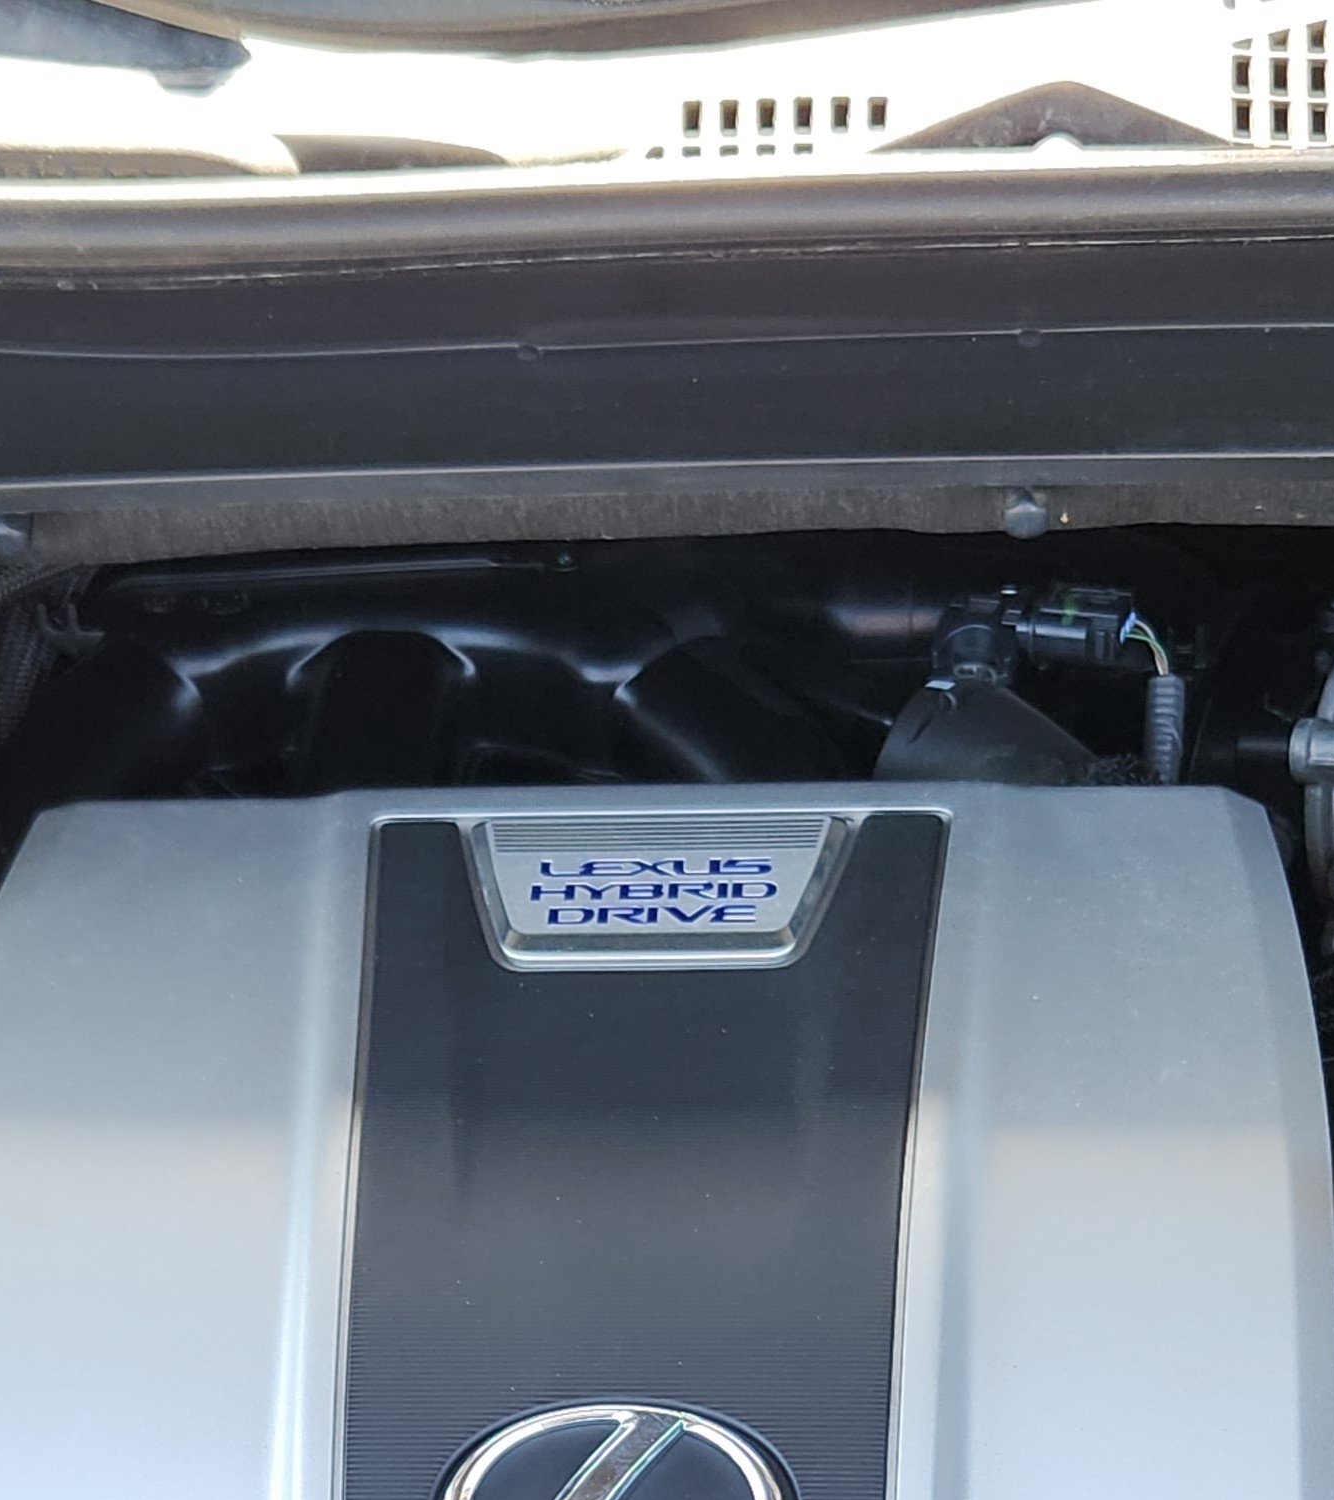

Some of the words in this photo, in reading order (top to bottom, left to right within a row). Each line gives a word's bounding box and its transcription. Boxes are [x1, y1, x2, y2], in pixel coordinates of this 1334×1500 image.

[539, 856, 772, 878] LEXUS
[529, 880, 778, 902] HYBRID
[546, 904, 758, 926] DRIVE
